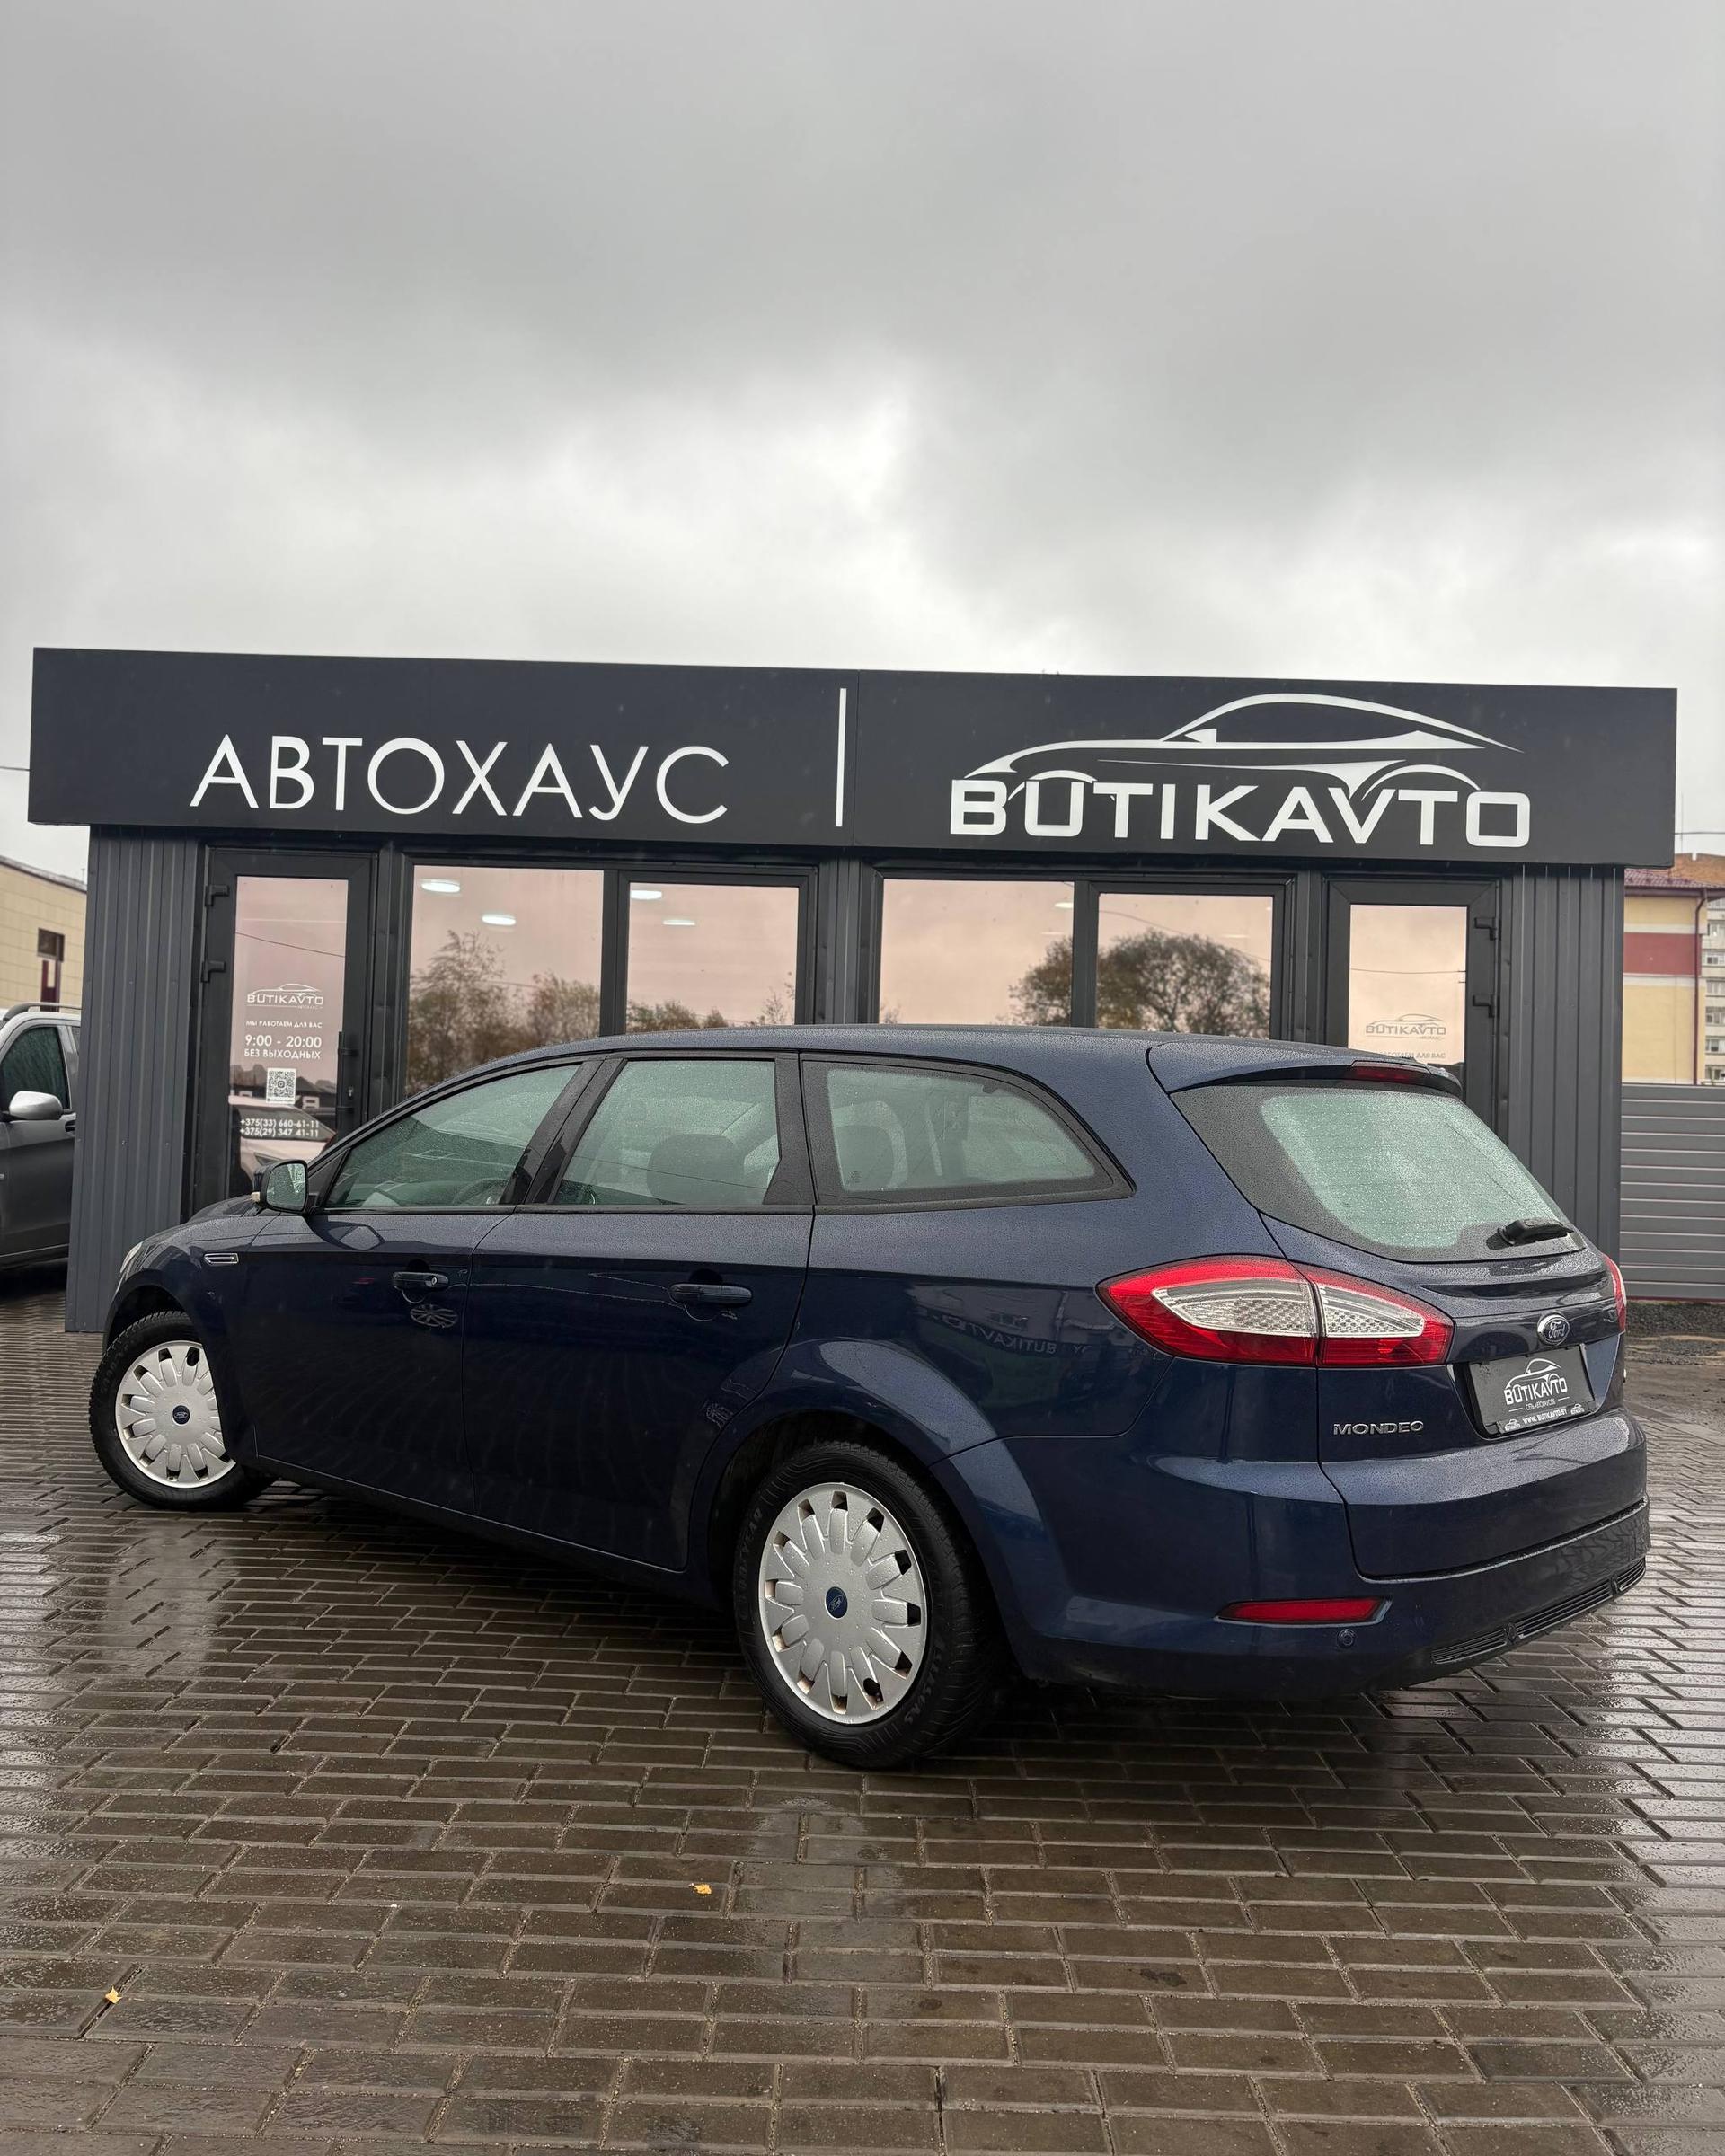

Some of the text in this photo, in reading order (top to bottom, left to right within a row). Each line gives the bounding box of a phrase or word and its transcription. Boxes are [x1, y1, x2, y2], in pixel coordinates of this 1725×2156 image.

[190, 734, 729, 823] АВТОХАУС
[950, 778, 1530, 848] BUTIKAVTO
[247, 994, 324, 1005] BUTIKAVTO
[1365, 1024, 1446, 1036] BUTIKAVTO
[244, 1034, 273, 1047] 9:00
[286, 1035, 323, 1048] 20:00
[244, 1048, 322, 1060] БЕЗ ВЫХОДНЫХ
[1503, 1377, 1568, 1406] BUTIKAVTO
[1333, 1420, 1424, 1436] MONDEO
